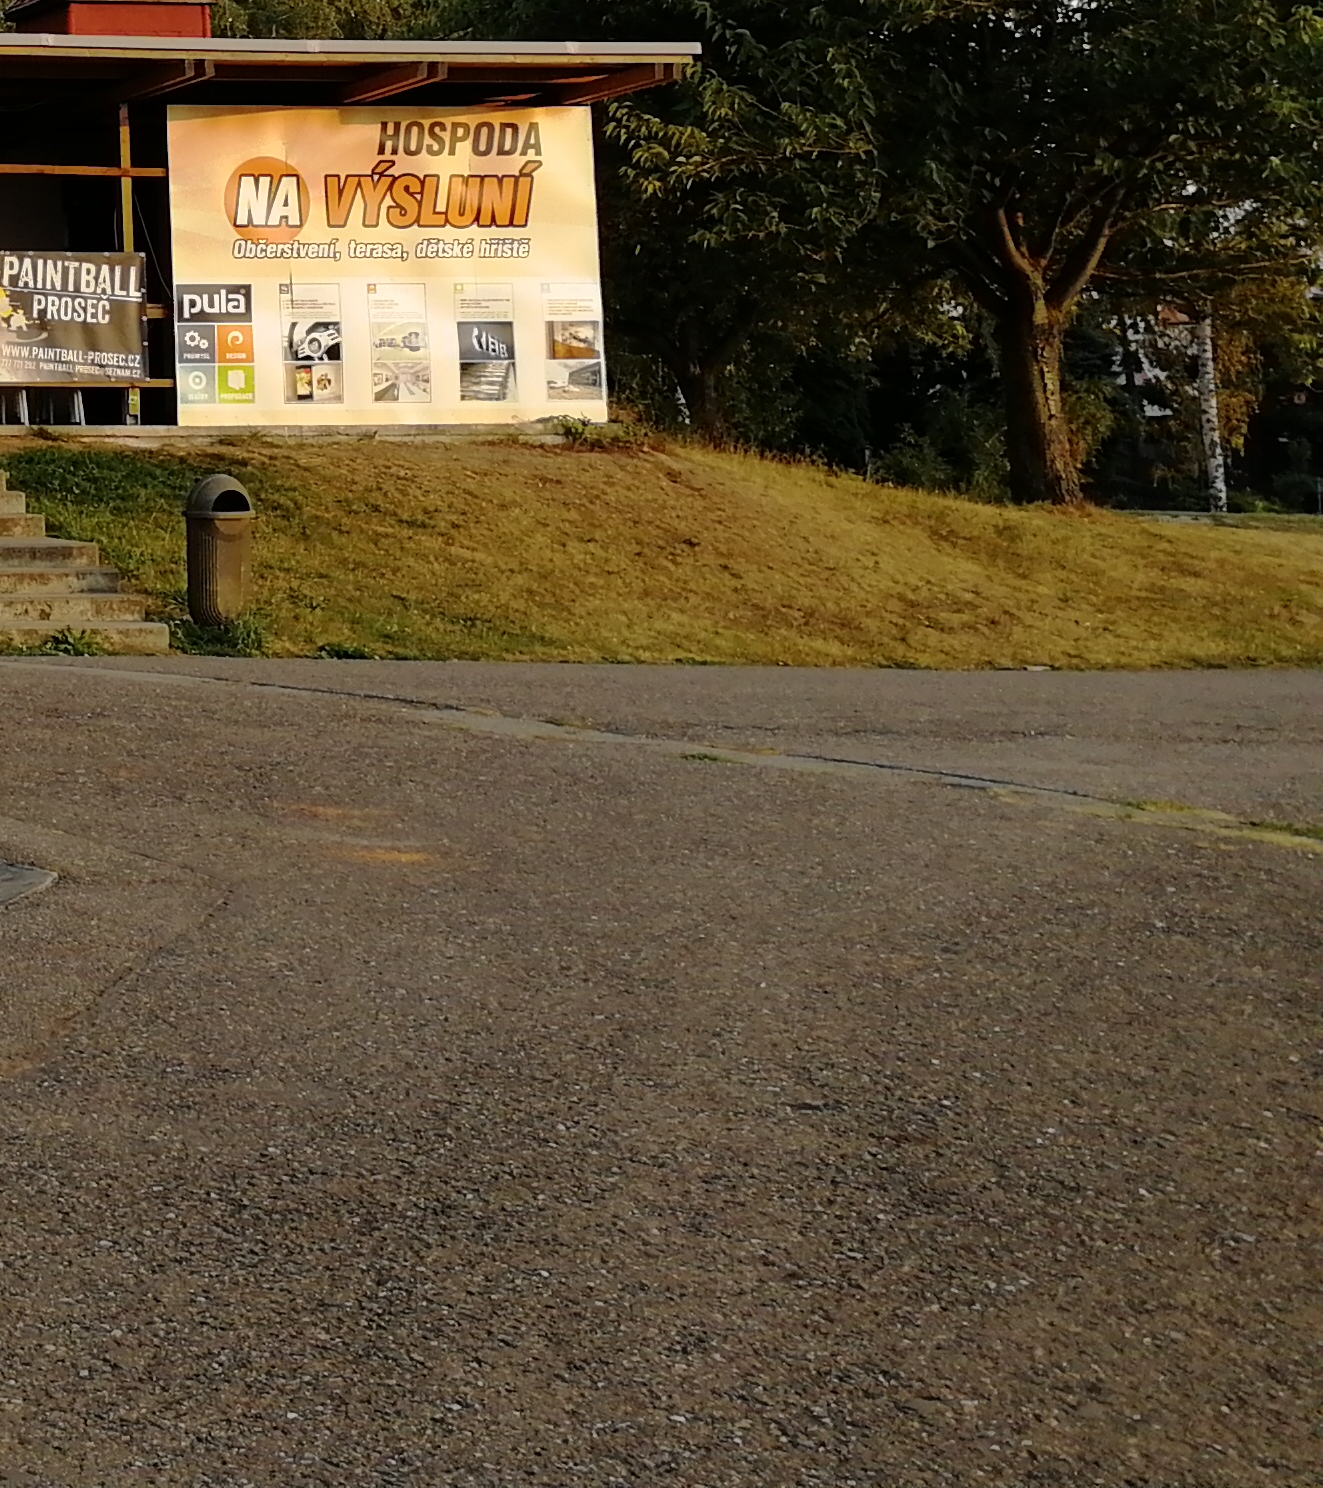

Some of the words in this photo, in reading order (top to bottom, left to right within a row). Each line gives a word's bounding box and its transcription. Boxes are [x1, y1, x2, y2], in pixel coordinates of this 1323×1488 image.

[377, 120, 542, 157] HOSPODA
[234, 173, 303, 228] NA
[324, 160, 543, 229] VÝSLUNÍ
[232, 238, 341, 261] Občerstvení,
[348, 239, 408, 261] terasa,
[415, 238, 475, 258] dětské
[478, 237, 531, 258] hřiště
[3, 255, 142, 297] PAINTBALL
[32, 294, 110, 324] PROSEČ
[182, 289, 246, 319] pula
[1, 344, 141, 367] WWW.PAINTBALL-PROSEC.CZ
